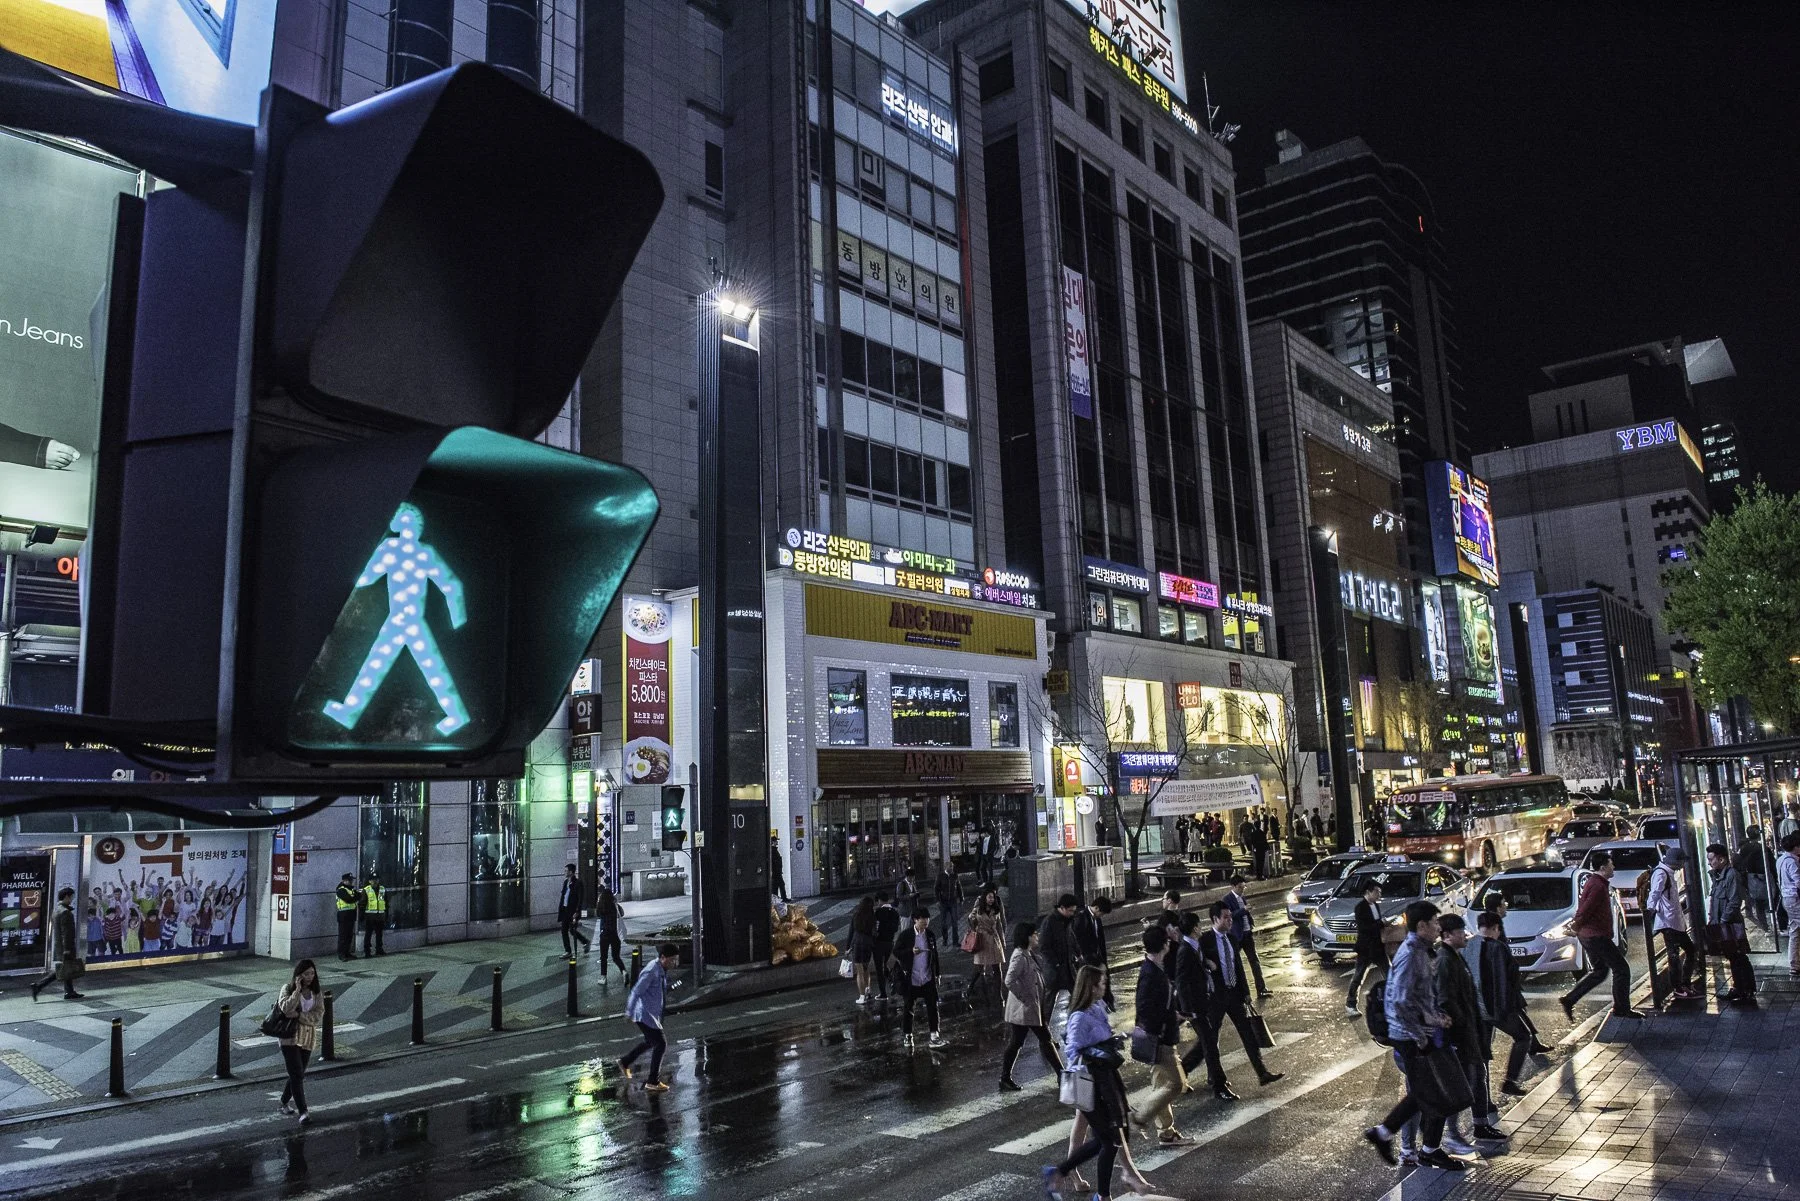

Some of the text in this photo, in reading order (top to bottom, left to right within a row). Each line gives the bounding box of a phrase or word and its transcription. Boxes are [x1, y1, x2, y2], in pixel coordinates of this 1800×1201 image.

[1143, 73, 1170, 111] 공무원
[881, 82, 954, 145] 리즈산부인과
[13, 317, 84, 349] Jeans
[1616, 420, 1677, 450] YBM
[803, 530, 871, 562] 리즈산부인과
[794, 550, 852, 580] 동방한의원
[896, 570, 944, 593] 굿필러의원
[1087, 565, 1150, 592] 그린컴퓨터아카데미
[629, 657, 668, 672] 치킨스테이크,
[639, 671, 658, 683] 파스타
[1179, 695, 1198, 707] QLO
[576, 702, 592, 729] 약
[572, 746, 592, 760] 부동산
[731, 813, 746, 829] 10
[102, 840, 121, 860] 약
[134, 833, 191, 877] 약
[187, 849, 247, 860] 병의원처방 조제
[1, 880, 46, 890] PHARMACY
[12, 872, 35, 881] WELL
[278, 897, 289, 920] 약
